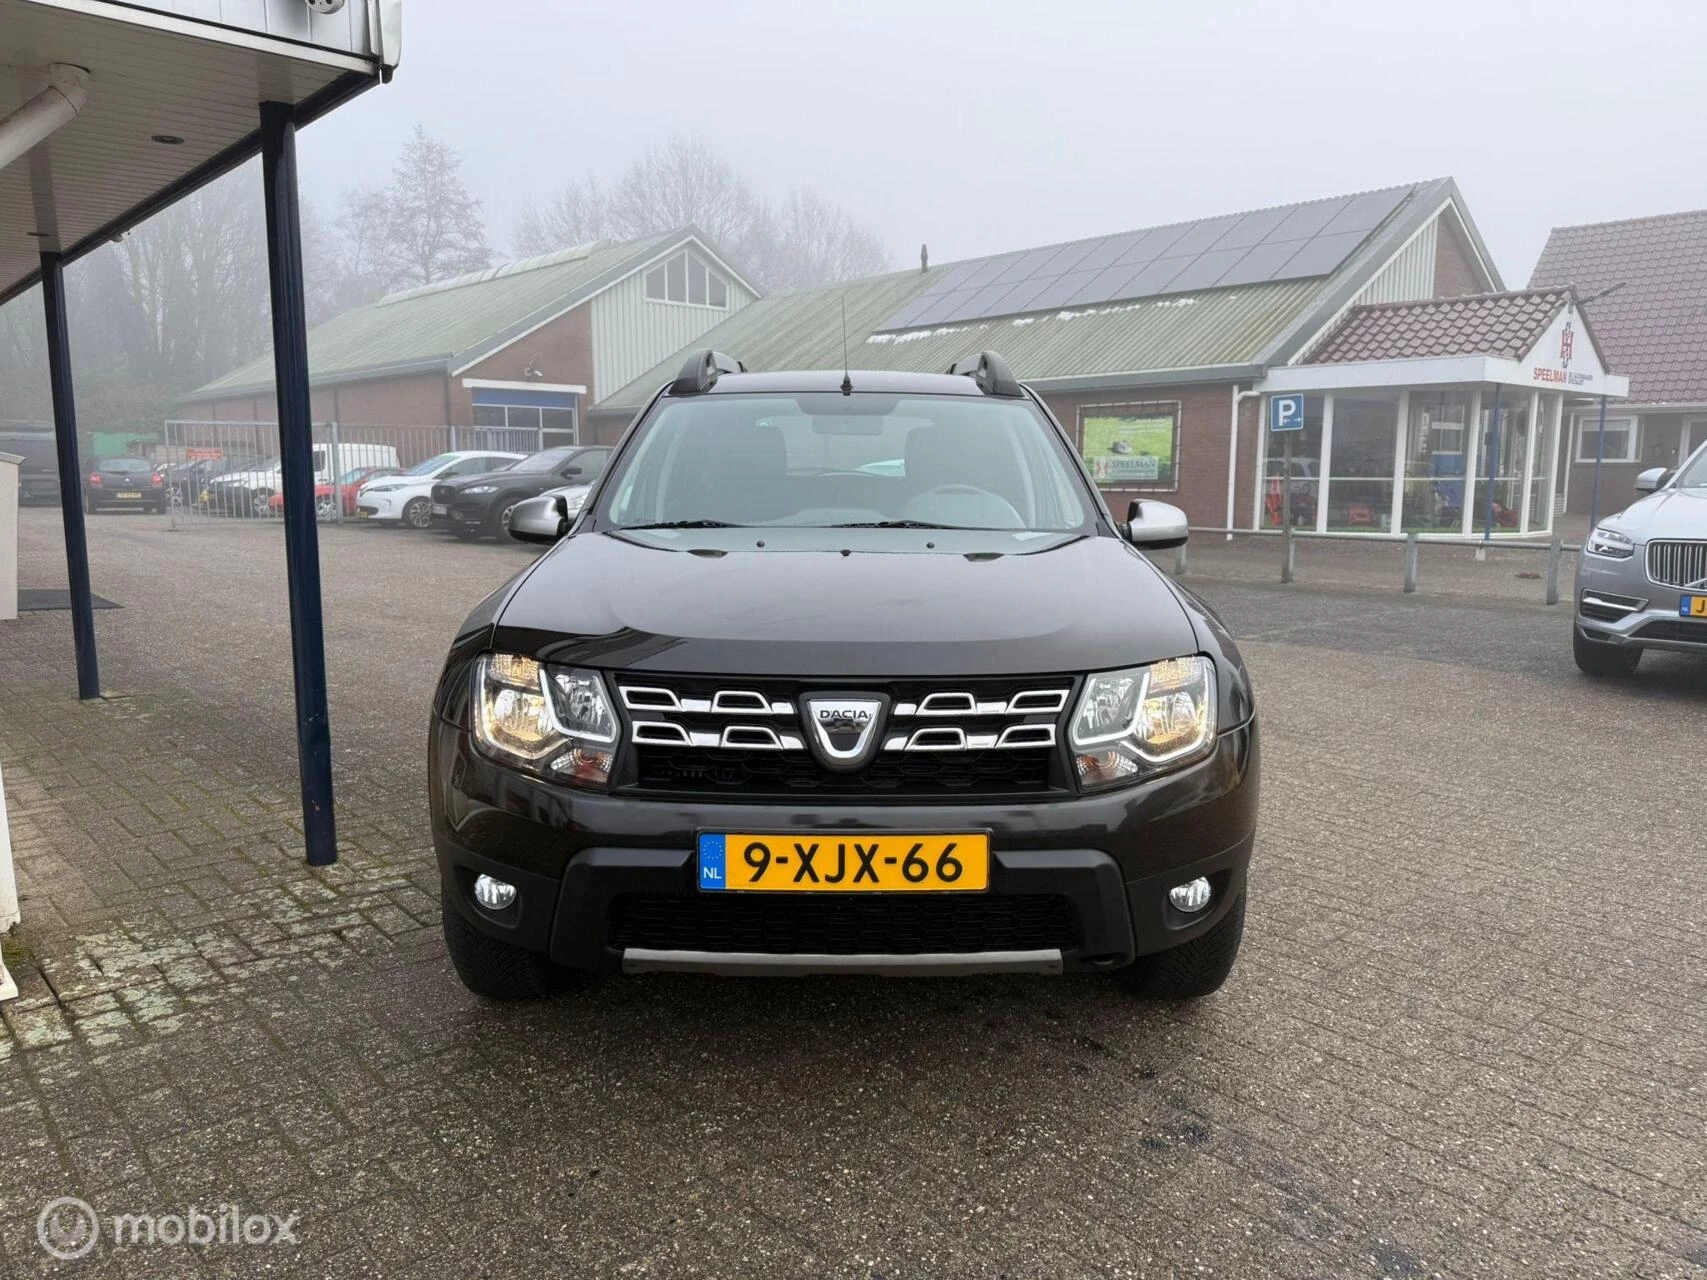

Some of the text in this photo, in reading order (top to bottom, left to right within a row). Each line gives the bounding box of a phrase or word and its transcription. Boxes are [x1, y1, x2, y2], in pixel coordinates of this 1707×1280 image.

[1533, 367, 1567, 384] SPEELMAN
[1279, 400, 1296, 426] P
[819, 710, 869, 719] DACIA
[743, 842, 963, 883] 9-XJX-66
[703, 867, 722, 879] NL
